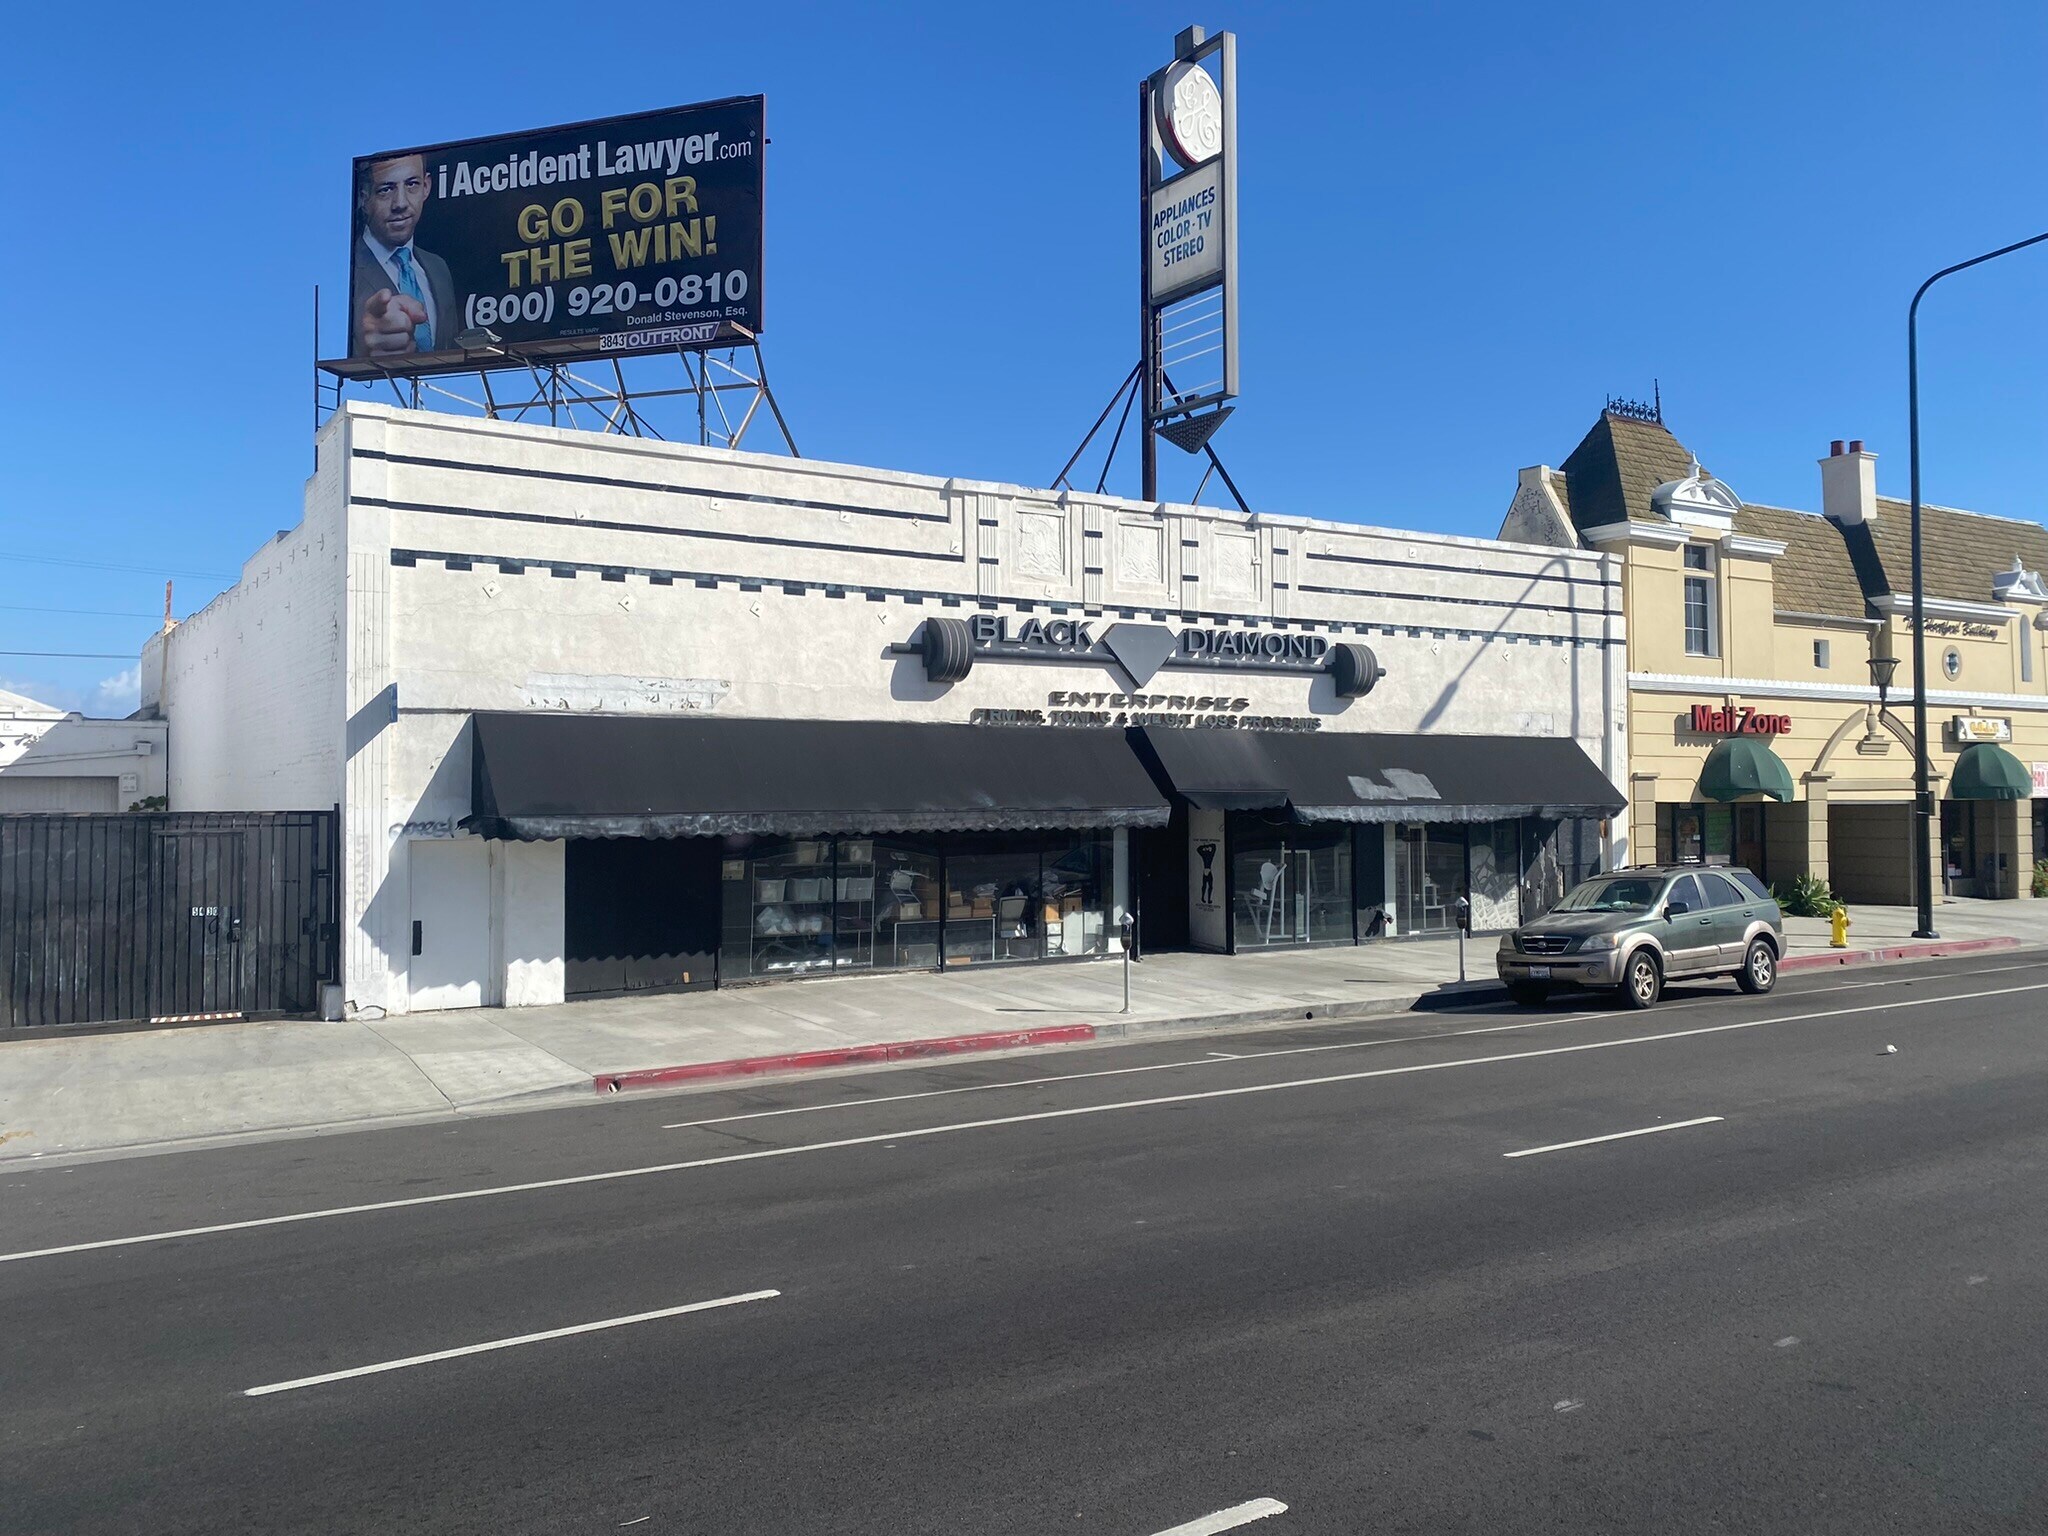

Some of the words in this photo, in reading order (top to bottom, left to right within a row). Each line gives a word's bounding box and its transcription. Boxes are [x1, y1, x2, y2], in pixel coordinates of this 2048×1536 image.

[517, 197, 584, 243] GO
[601, 175, 699, 229] FOR
[1153, 186, 1216, 230] APPLIANCES
[501, 238, 592, 288] THE
[608, 215, 717, 270] WIN!
[1163, 235, 1204, 267] STEREO
[465, 286, 555, 329] (800)
[567, 269, 748, 317] 920-0810
[626, 313, 662, 326] Donald
[664, 309, 723, 322] Stevenson,
[725, 306, 748, 317] Esq.
[601, 334, 625, 348] 3843
[628, 325, 714, 347] OUTFRONT
[974, 614, 1094, 646] BLACK
[1184, 628, 1328, 659] DIAMOND
[1047, 691, 1250, 712] ENTERPRISES
[1194, 714, 1238, 729] LOSS
[1691, 704, 1738, 733] Mail
[1739, 706, 1792, 734] Zone
